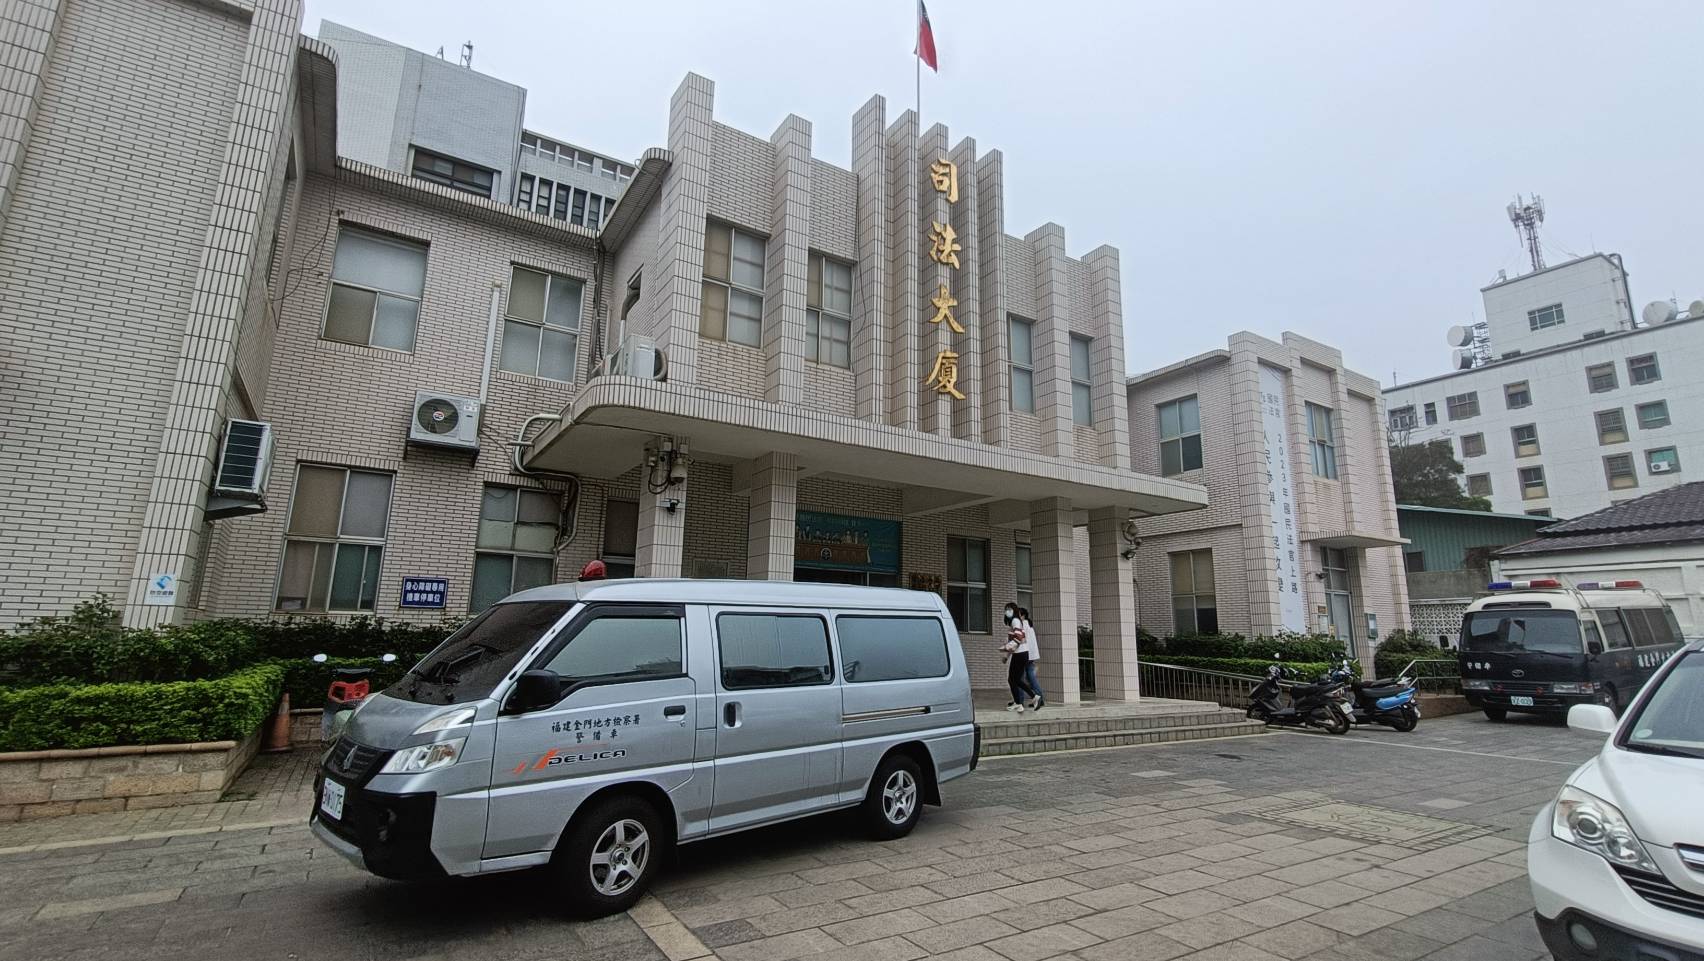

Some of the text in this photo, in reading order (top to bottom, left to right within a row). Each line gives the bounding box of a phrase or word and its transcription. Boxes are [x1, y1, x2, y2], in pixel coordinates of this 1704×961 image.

[925, 157, 966, 400] 司法大廈
[551, 714, 641, 733] 福建金門地方檢察署
[575, 729, 619, 744] 警備車
[548, 749, 627, 766] DELICA
